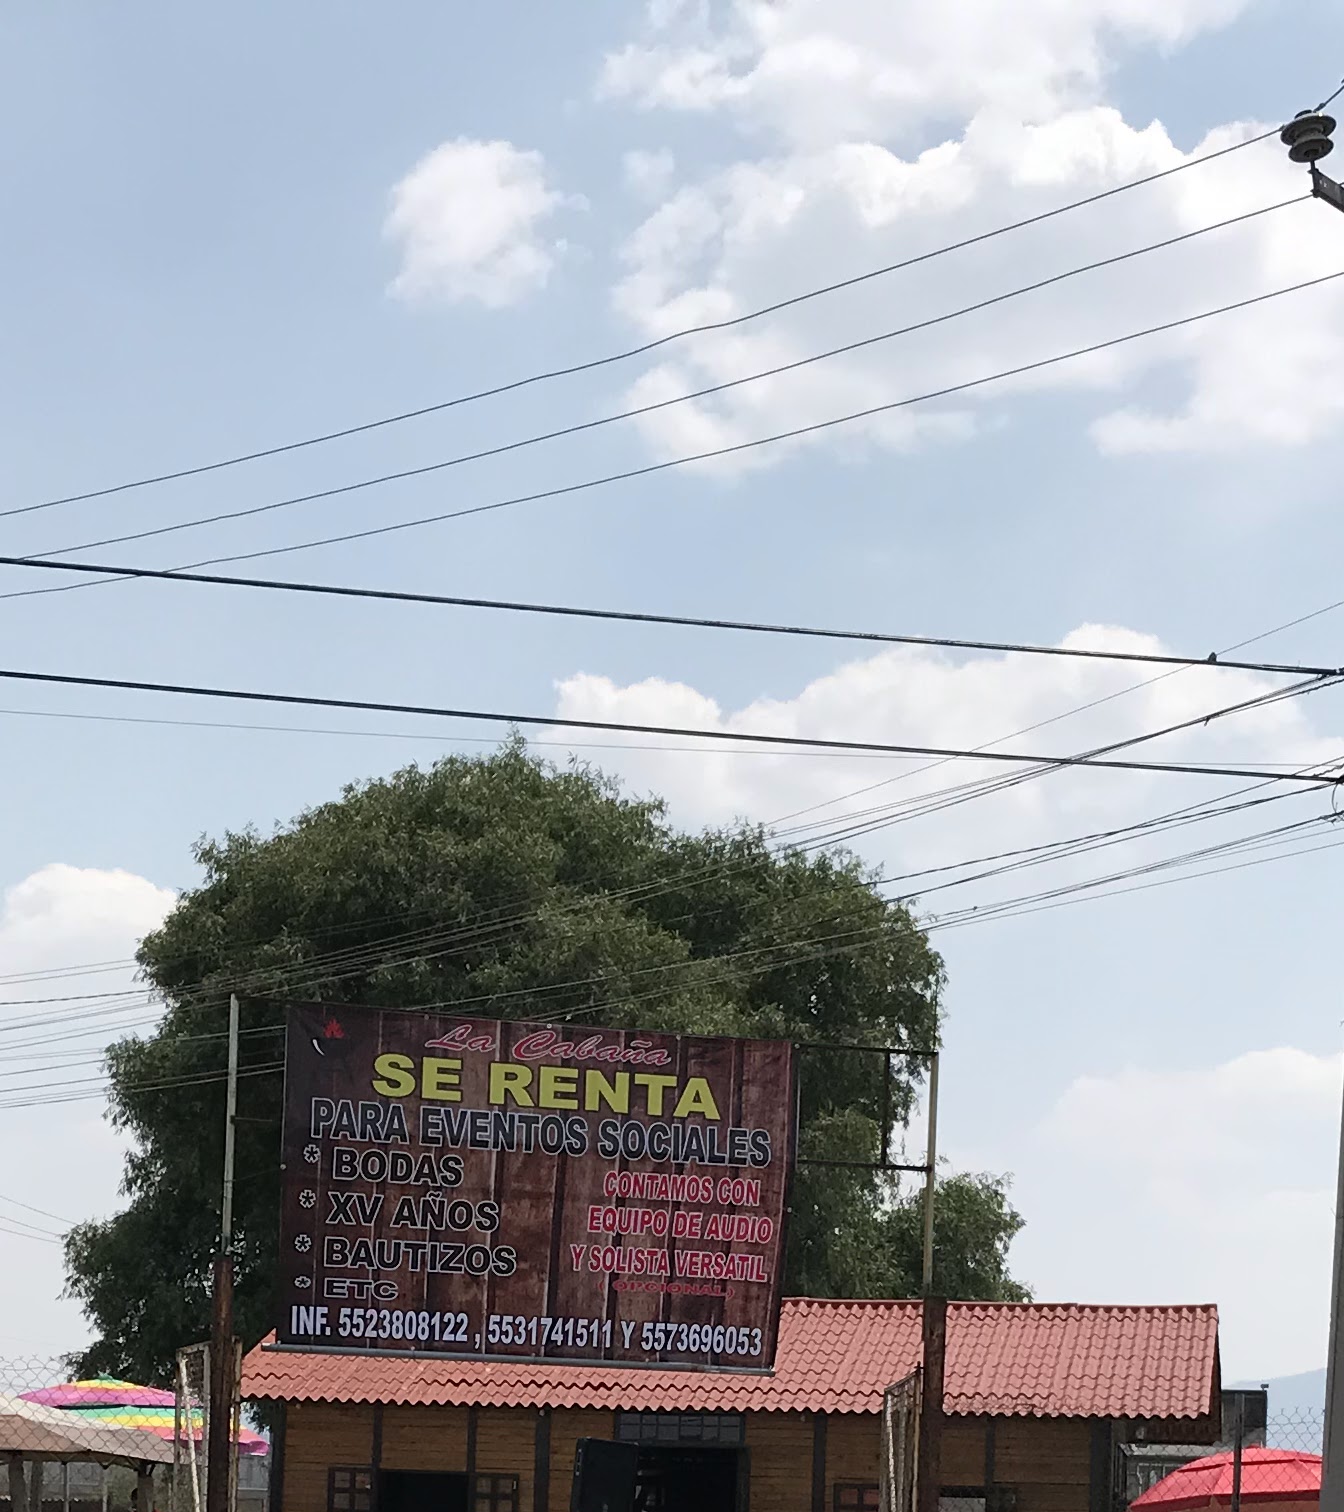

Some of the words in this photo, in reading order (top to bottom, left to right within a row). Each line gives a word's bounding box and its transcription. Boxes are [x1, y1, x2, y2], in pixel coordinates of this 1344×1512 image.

[425, 1024, 496, 1053] La
[513, 1031, 672, 1066] Cabaña
[372, 1053, 463, 1102] SE
[489, 1062, 721, 1121] RENTA
[311, 1098, 409, 1145] PARA
[420, 1106, 588, 1157] EVENTOS
[598, 1119, 771, 1168] SOCIALES
[333, 1147, 464, 1187] BODAS
[603, 1171, 713, 1203] CONTAMOS
[717, 1177, 761, 1206] CON
[326, 1191, 384, 1226] XV
[390, 1191, 499, 1233] AÑOS
[588, 1205, 669, 1236] EQUIPO
[672, 1210, 703, 1239] DE
[704, 1213, 773, 1244] AUDIO
[324, 1236, 517, 1277] BAUTIZOS
[570, 1244, 585, 1271] Y
[588, 1245, 670, 1276] SOLISTA
[674, 1250, 768, 1282] VERSATIL
[324, 1278, 399, 1301] ETC
[290, 1305, 332, 1336] INF.
[488, 1315, 613, 1347] 5531741511
[620, 1321, 636, 1348] Y
[641, 1323, 763, 1356] 5573696053
